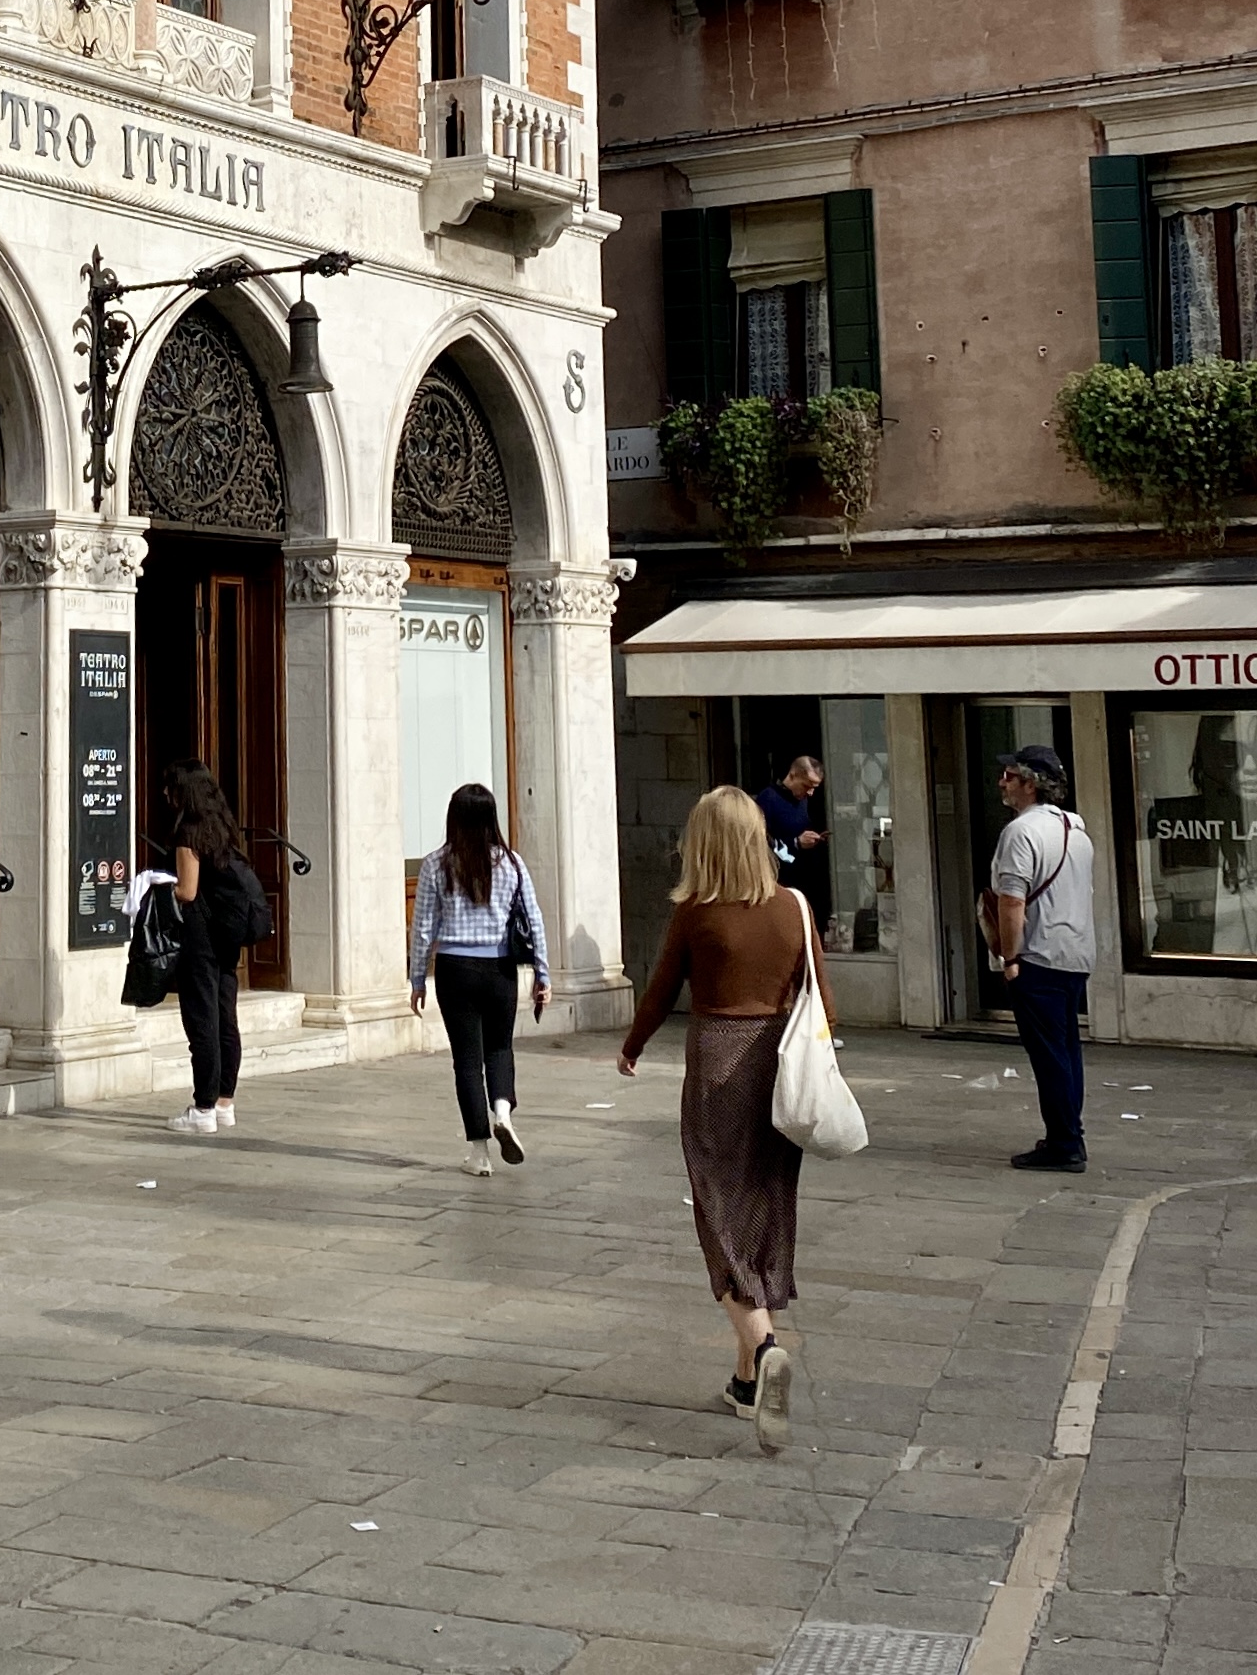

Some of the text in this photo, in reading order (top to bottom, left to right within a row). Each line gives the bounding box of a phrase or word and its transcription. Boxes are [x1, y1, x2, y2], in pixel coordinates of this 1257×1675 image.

[121, 125, 266, 213] ITALIA
[79, 652, 126, 669] TEATRO
[81, 670, 126, 688] ITALIA
[89, 749, 117, 762] APERTO
[1156, 819, 1225, 840] SAINT
